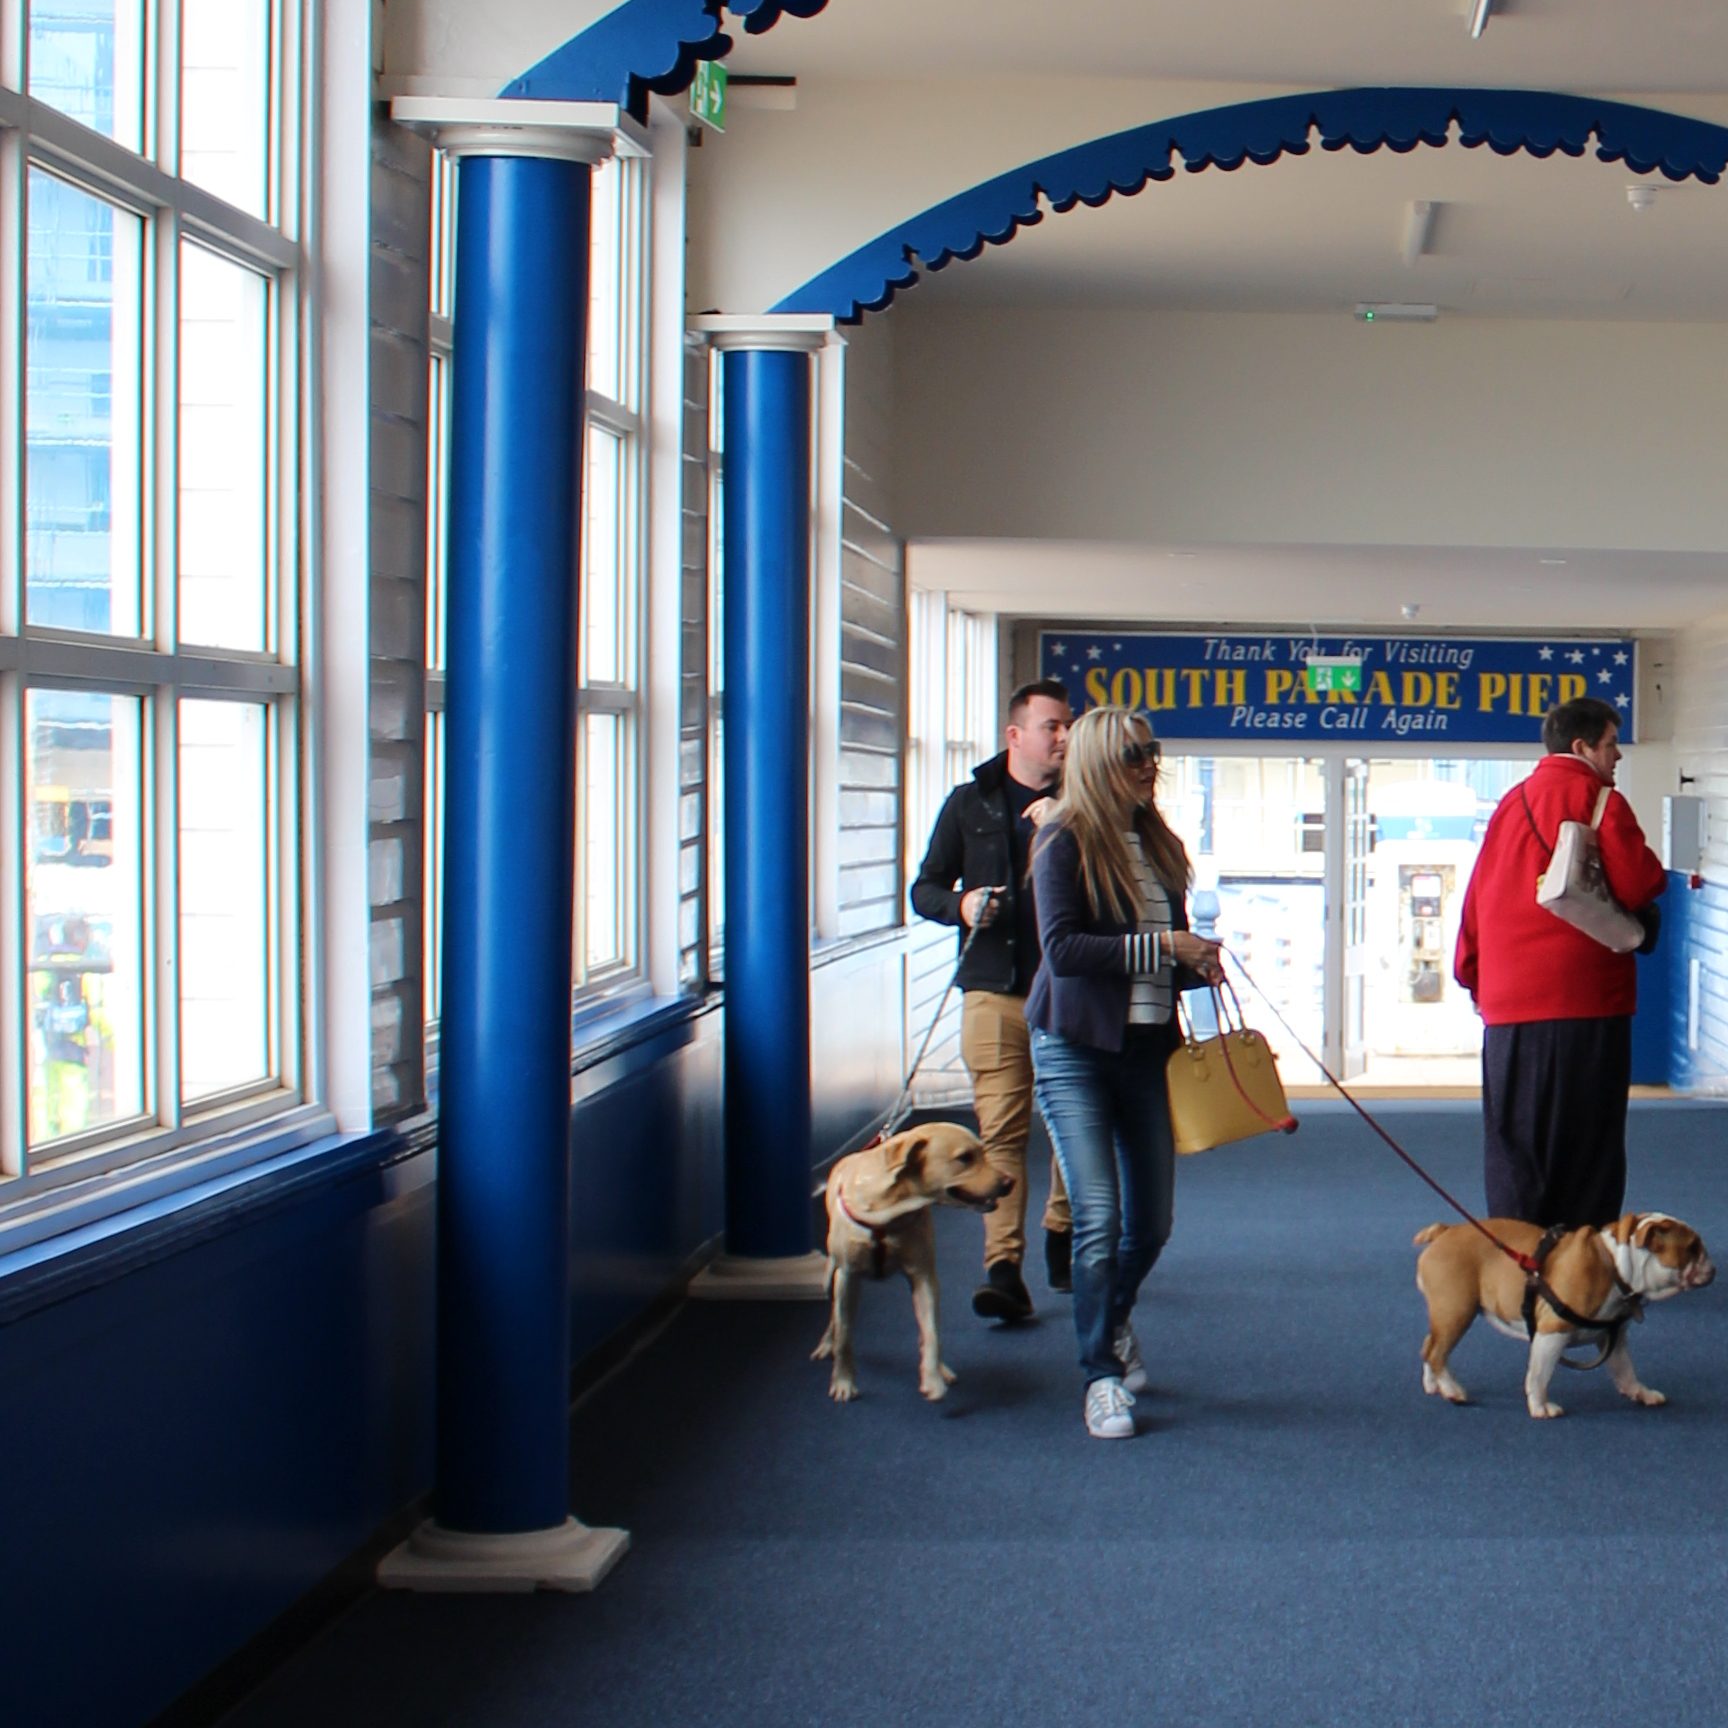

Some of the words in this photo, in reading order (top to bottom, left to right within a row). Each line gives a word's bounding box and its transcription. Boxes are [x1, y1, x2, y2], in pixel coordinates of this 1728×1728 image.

[1203, 639, 1276, 661] Thank
[1288, 640, 1327, 661] You
[1341, 641, 1373, 661] for
[1385, 642, 1475, 670] Visiting
[1084, 667, 1248, 712] SOUTH
[1477, 672, 1588, 718] PIER
[1230, 706, 1308, 729] Please
[1319, 707, 1369, 729] Call
[1381, 709, 1449, 735] Again
